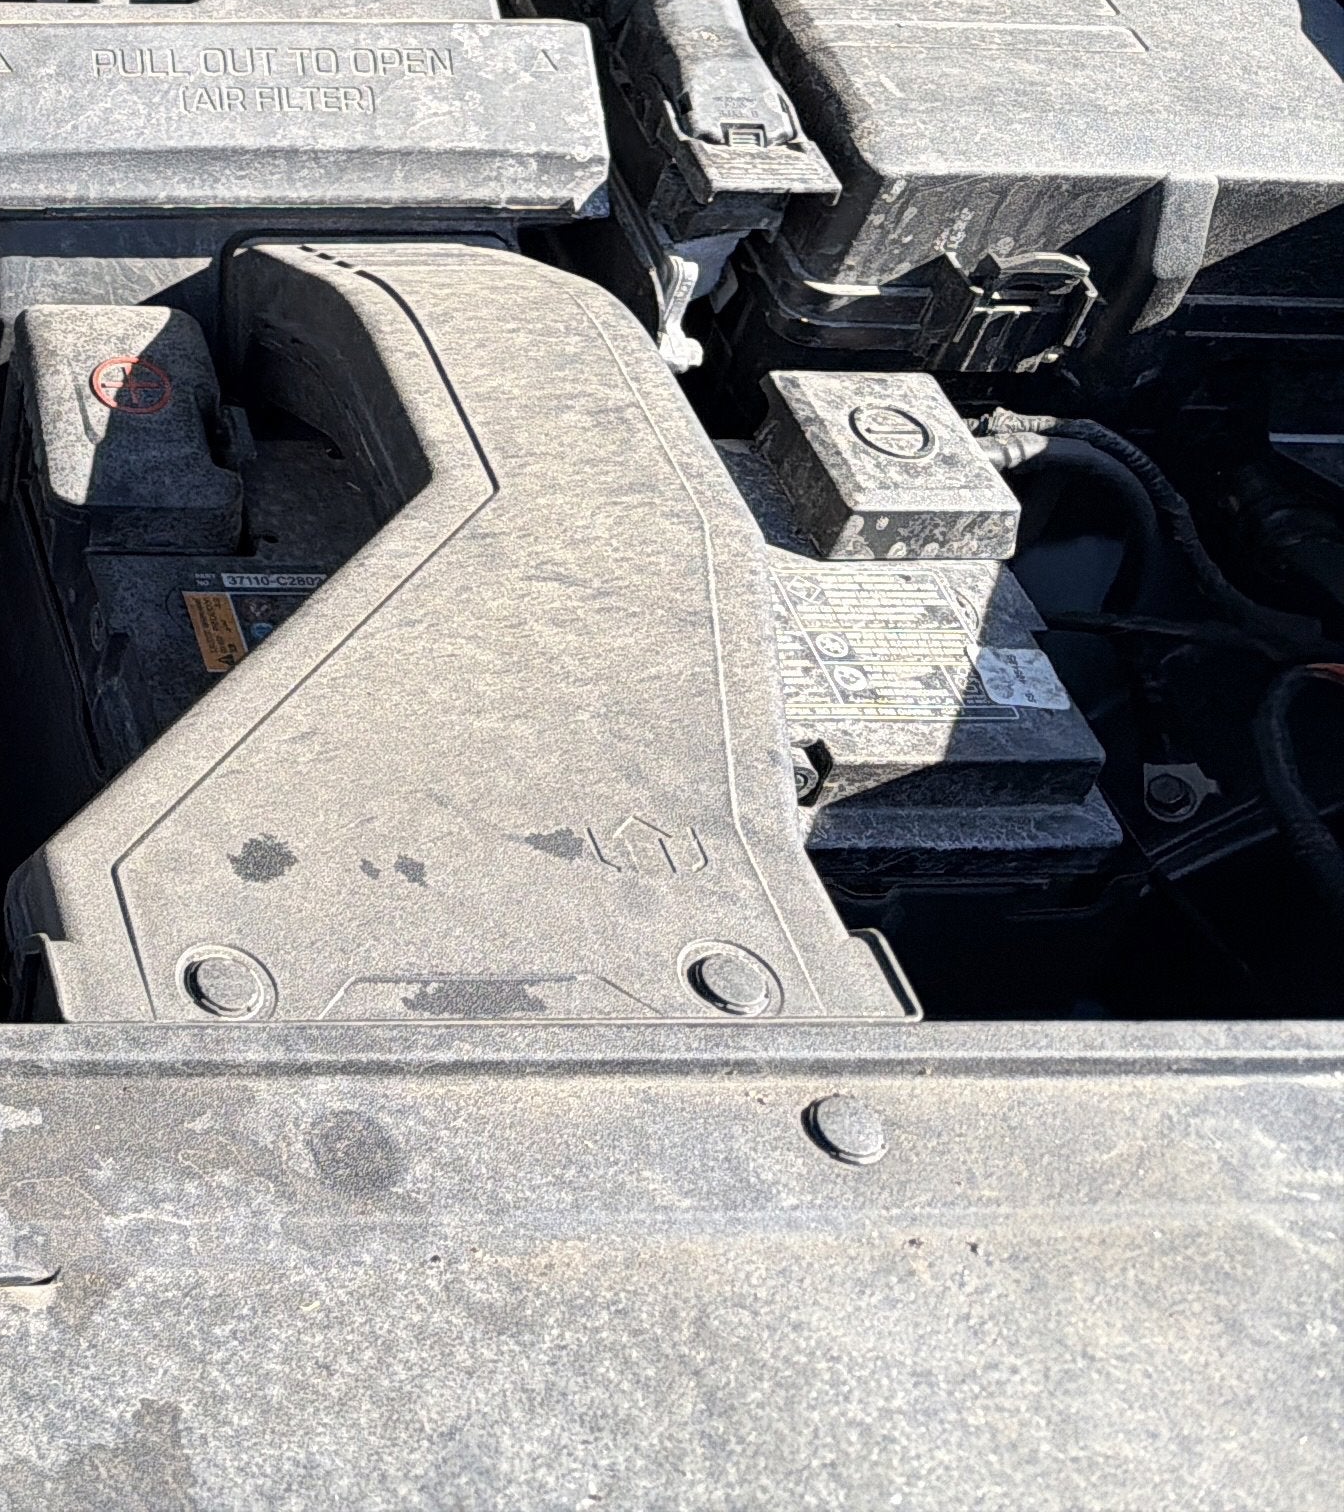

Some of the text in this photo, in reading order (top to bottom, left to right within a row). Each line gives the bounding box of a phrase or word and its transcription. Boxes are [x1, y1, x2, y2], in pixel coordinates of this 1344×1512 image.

[92, 48, 453, 77] PULL OUT TO OPEN
[179, 86, 376, 114] (AIR FILTER)
